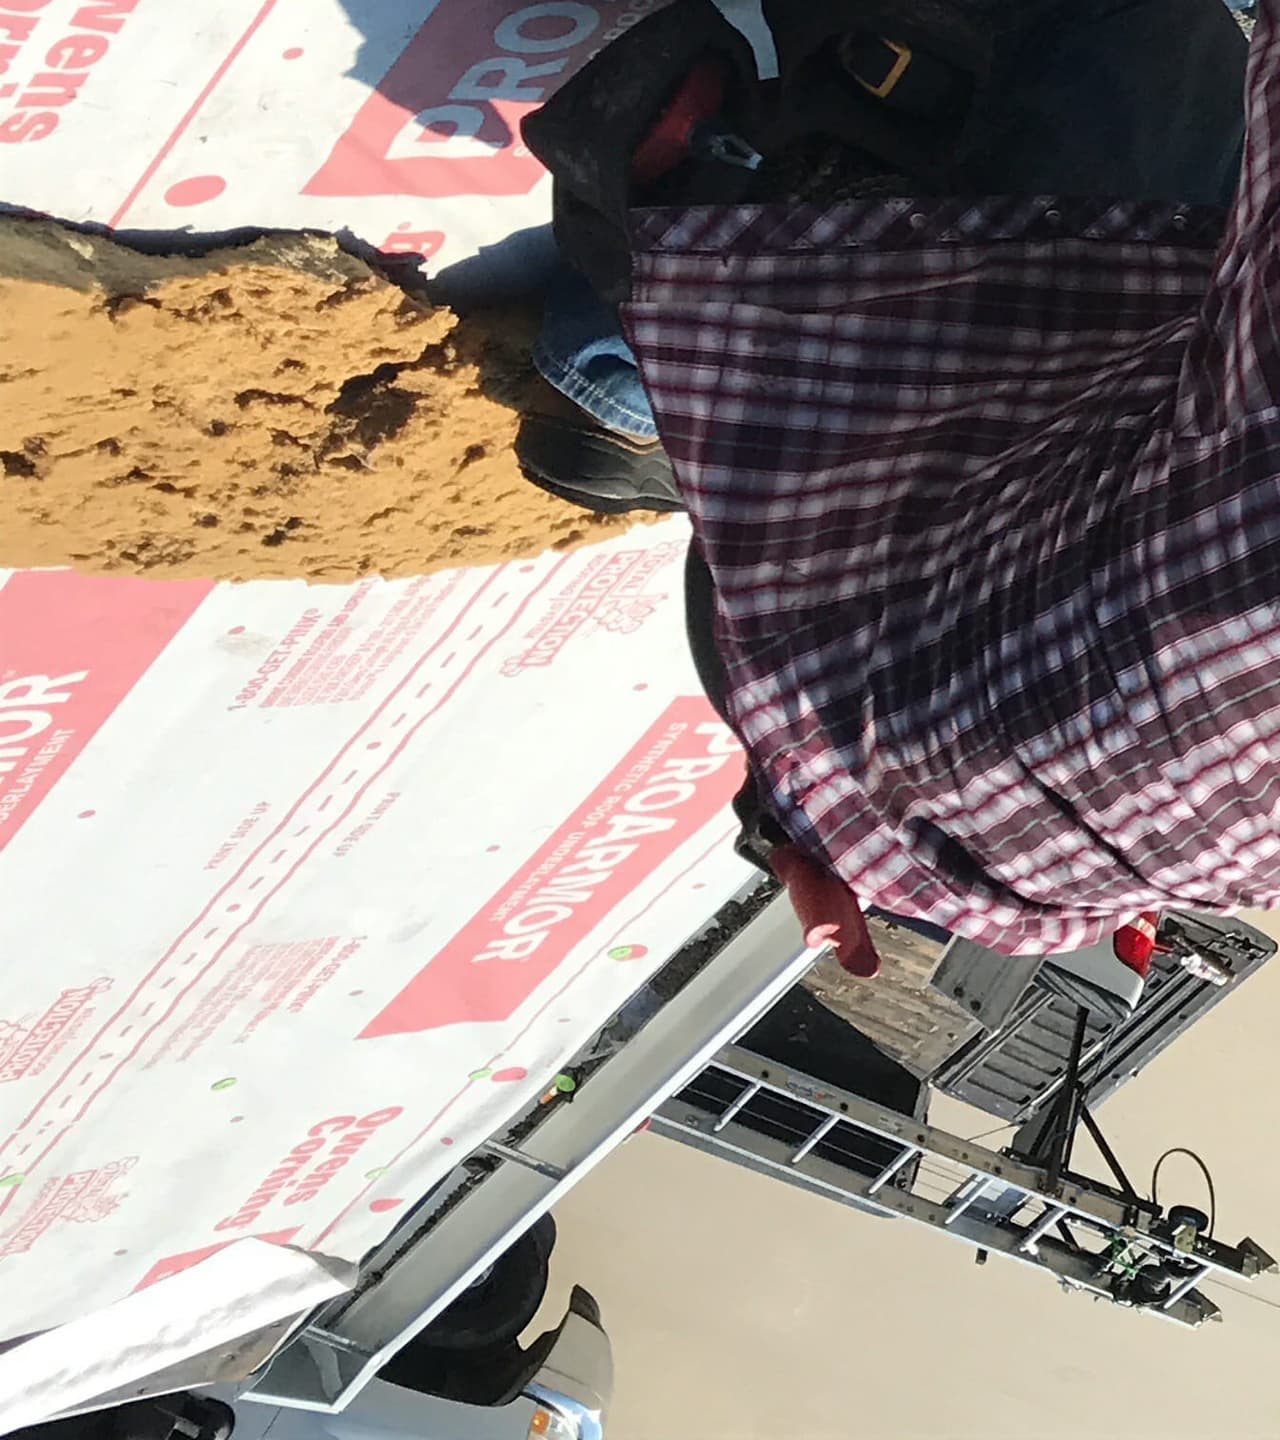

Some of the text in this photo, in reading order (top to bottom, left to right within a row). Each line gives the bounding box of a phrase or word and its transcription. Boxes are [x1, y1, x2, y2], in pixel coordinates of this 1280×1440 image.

[614, 722, 688, 792] SYNTHETIC
[582, 795, 618, 828] ROOF
[283, 1106, 404, 1206] Owens
